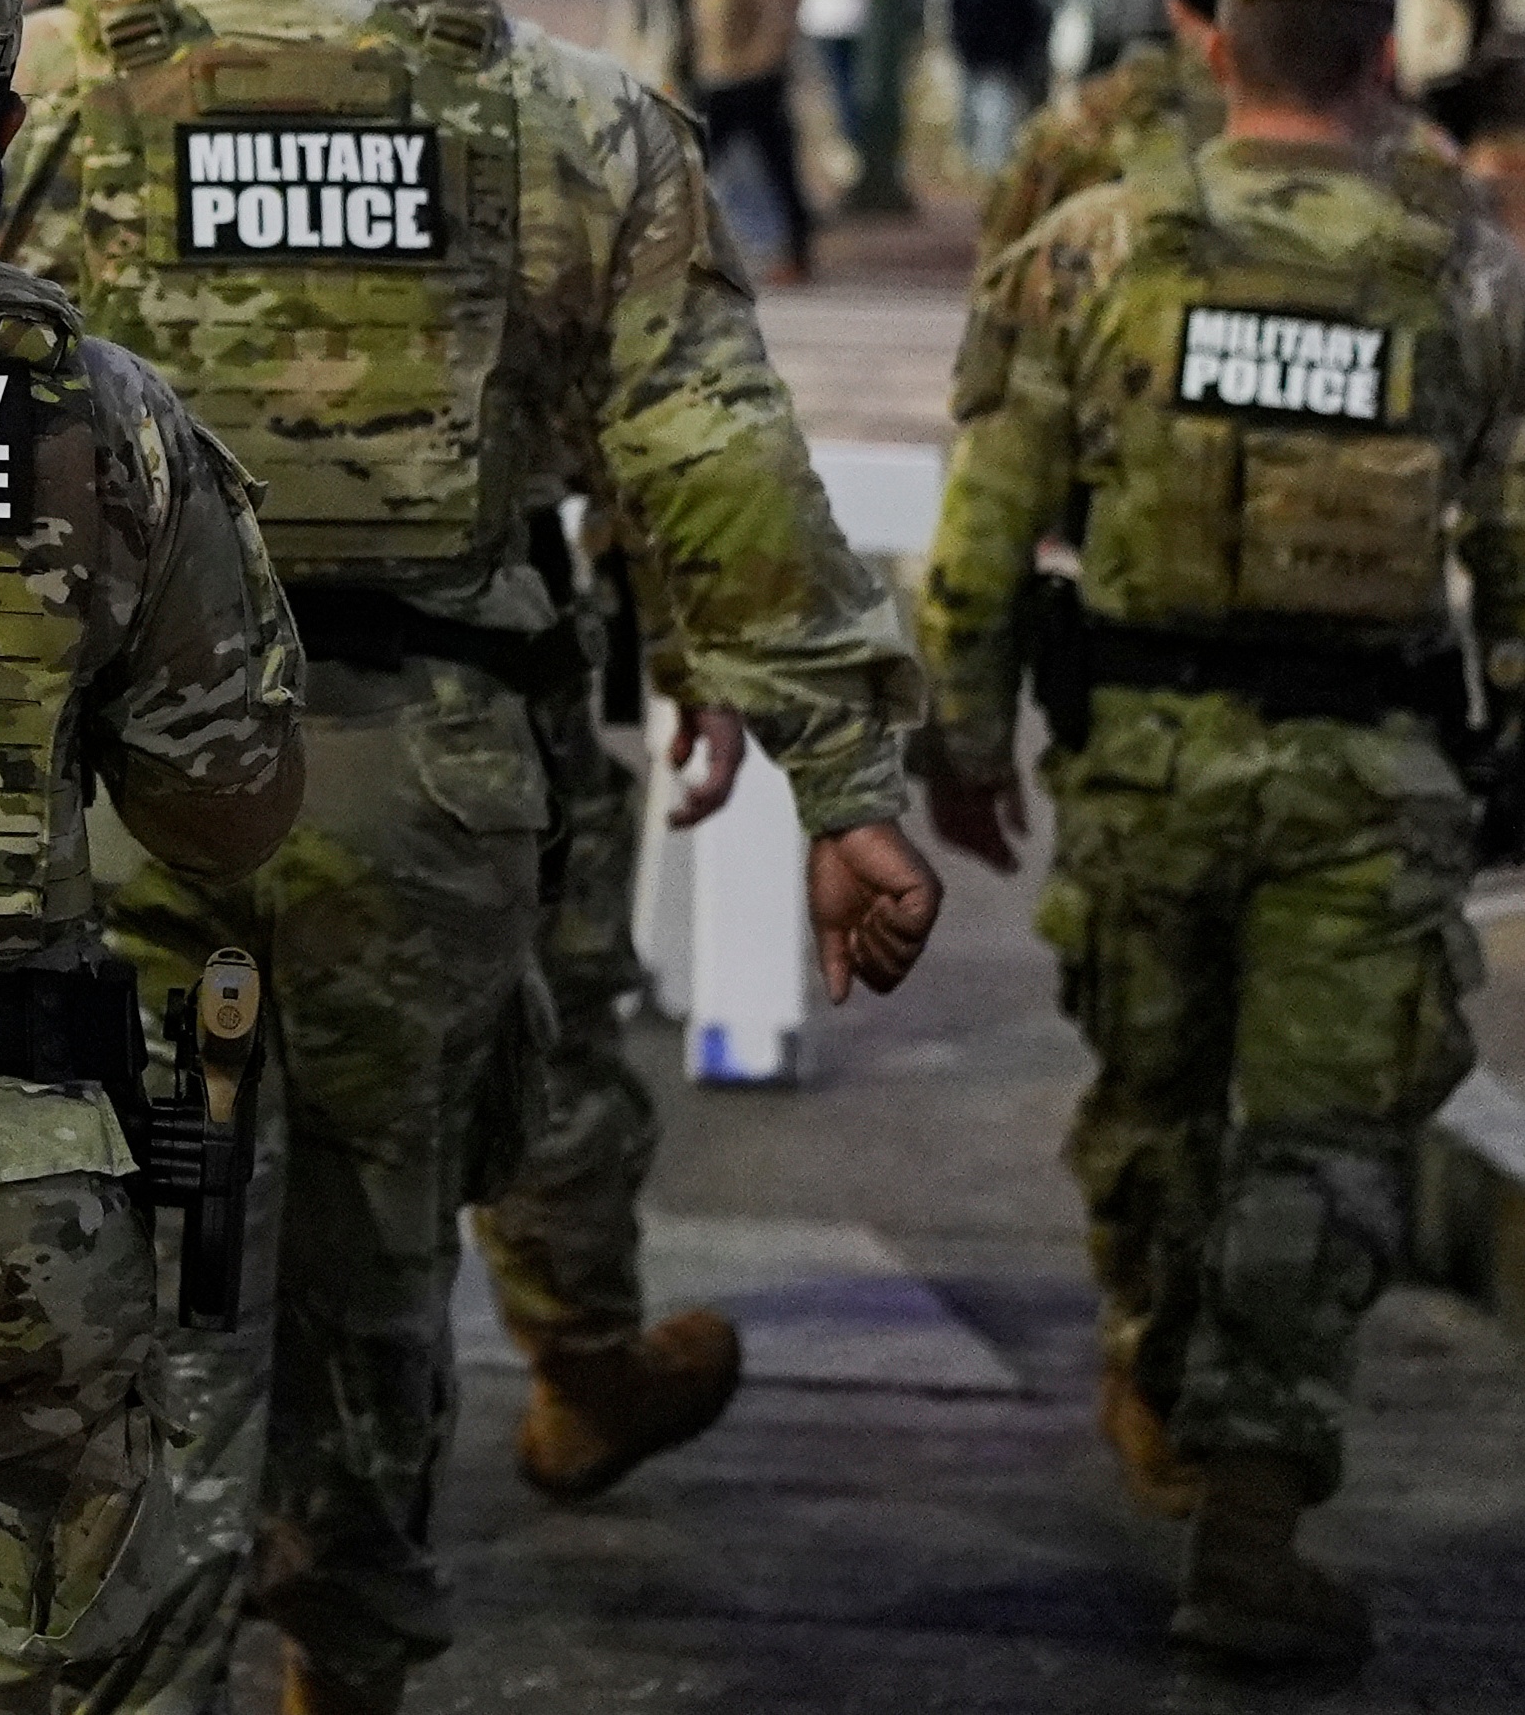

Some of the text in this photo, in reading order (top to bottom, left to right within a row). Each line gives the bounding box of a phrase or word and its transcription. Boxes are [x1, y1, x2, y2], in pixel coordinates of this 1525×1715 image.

[188, 132, 425, 185] MILITARY
[190, 185, 432, 250] POLICE
[1186, 307, 1385, 368] MILITARY
[1180, 352, 1382, 421] POLICE
